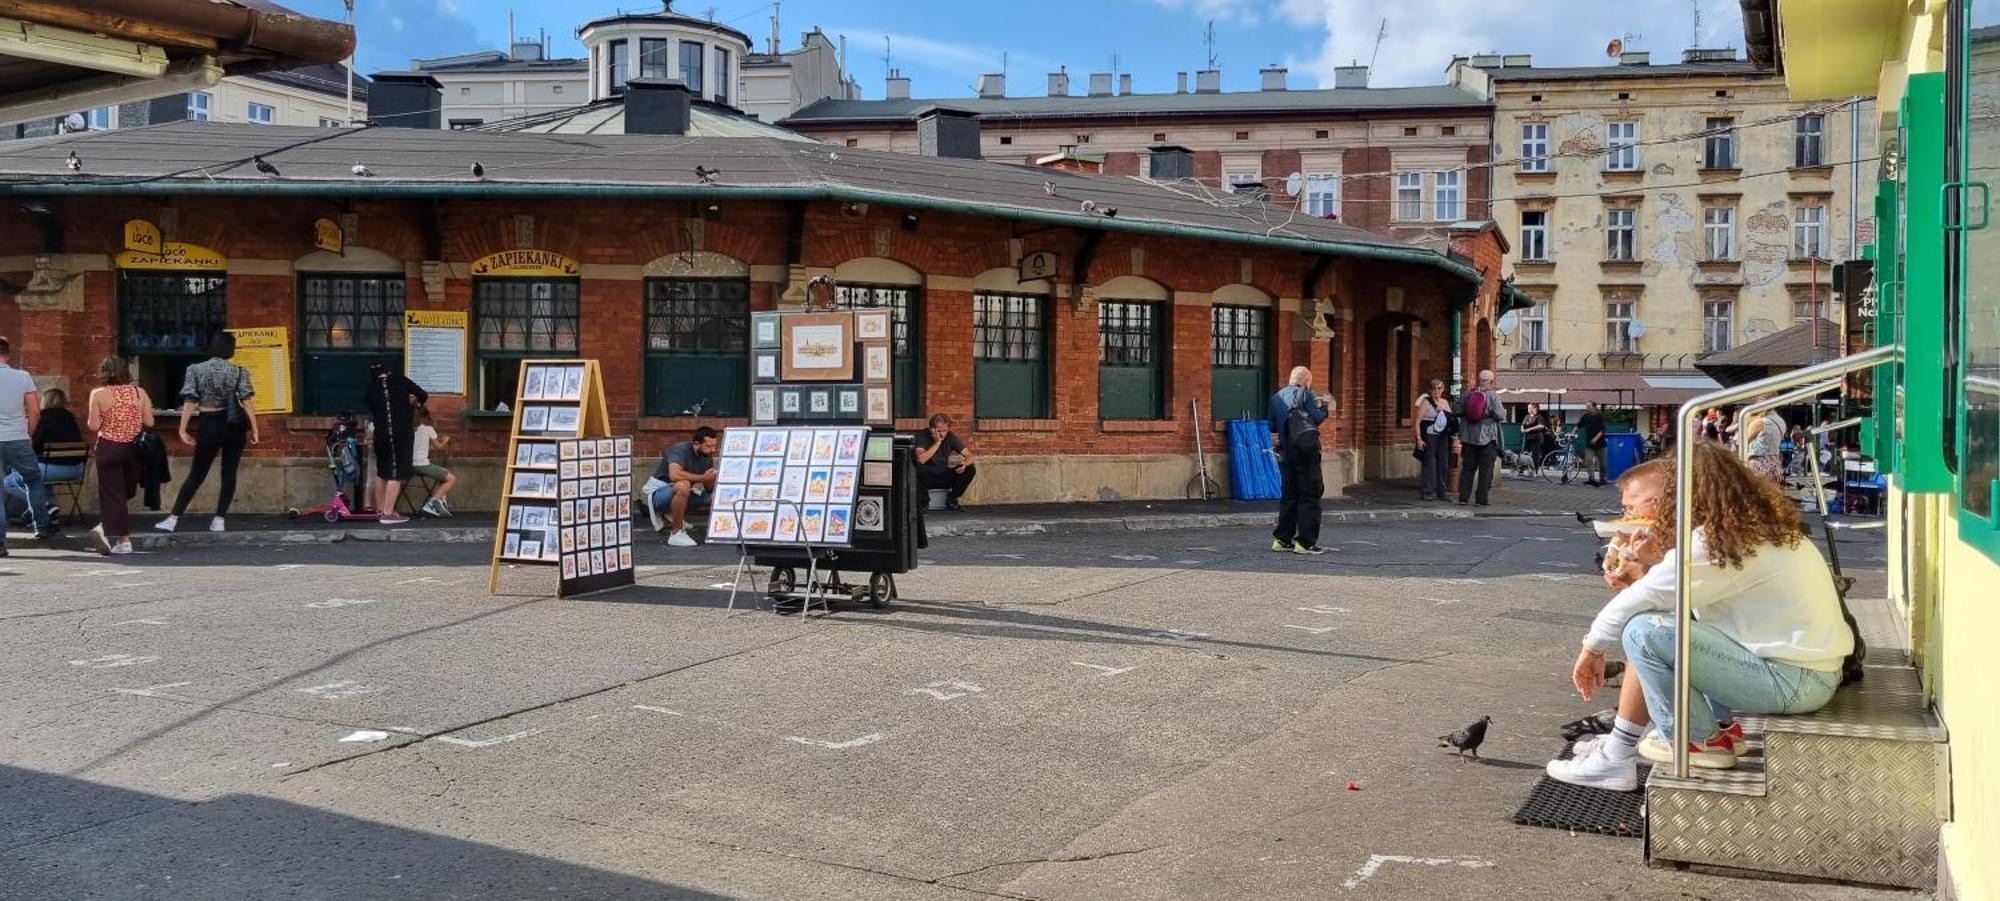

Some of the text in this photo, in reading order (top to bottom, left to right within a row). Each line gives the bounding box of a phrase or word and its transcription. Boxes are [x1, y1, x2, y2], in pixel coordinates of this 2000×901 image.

[129, 256, 219, 265] ZAPIEKANKI
[491, 251, 564, 269] ZAPIEKANKI
[237, 329, 278, 339] APIEKANKI
